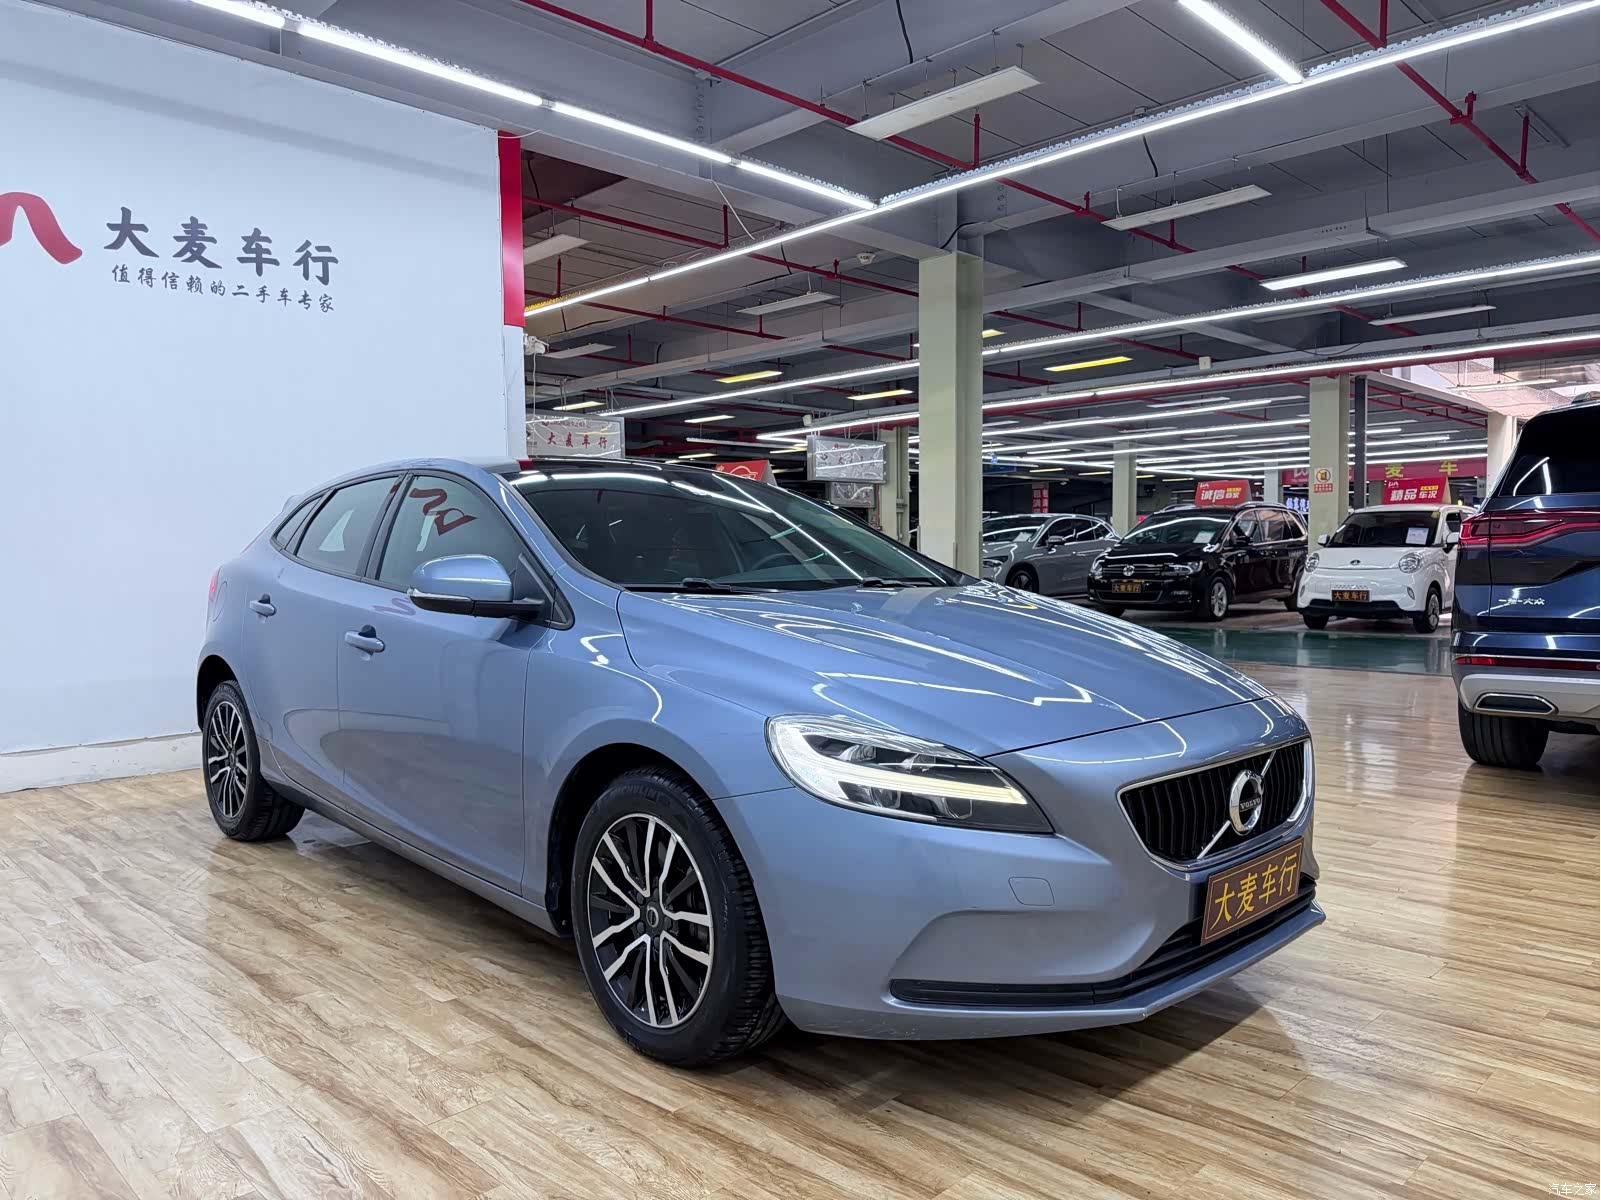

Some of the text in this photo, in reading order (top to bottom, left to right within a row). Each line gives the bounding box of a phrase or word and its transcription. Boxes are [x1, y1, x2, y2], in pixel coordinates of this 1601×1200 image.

[104, 206, 339, 285] 大麦车行
[112, 264, 334, 313] 值得信赖的二手车专家
[547, 432, 607, 449] 大麦车行
[1239, 797, 1261, 809] VOLVO
[1210, 852, 1298, 930] 大麦车行
